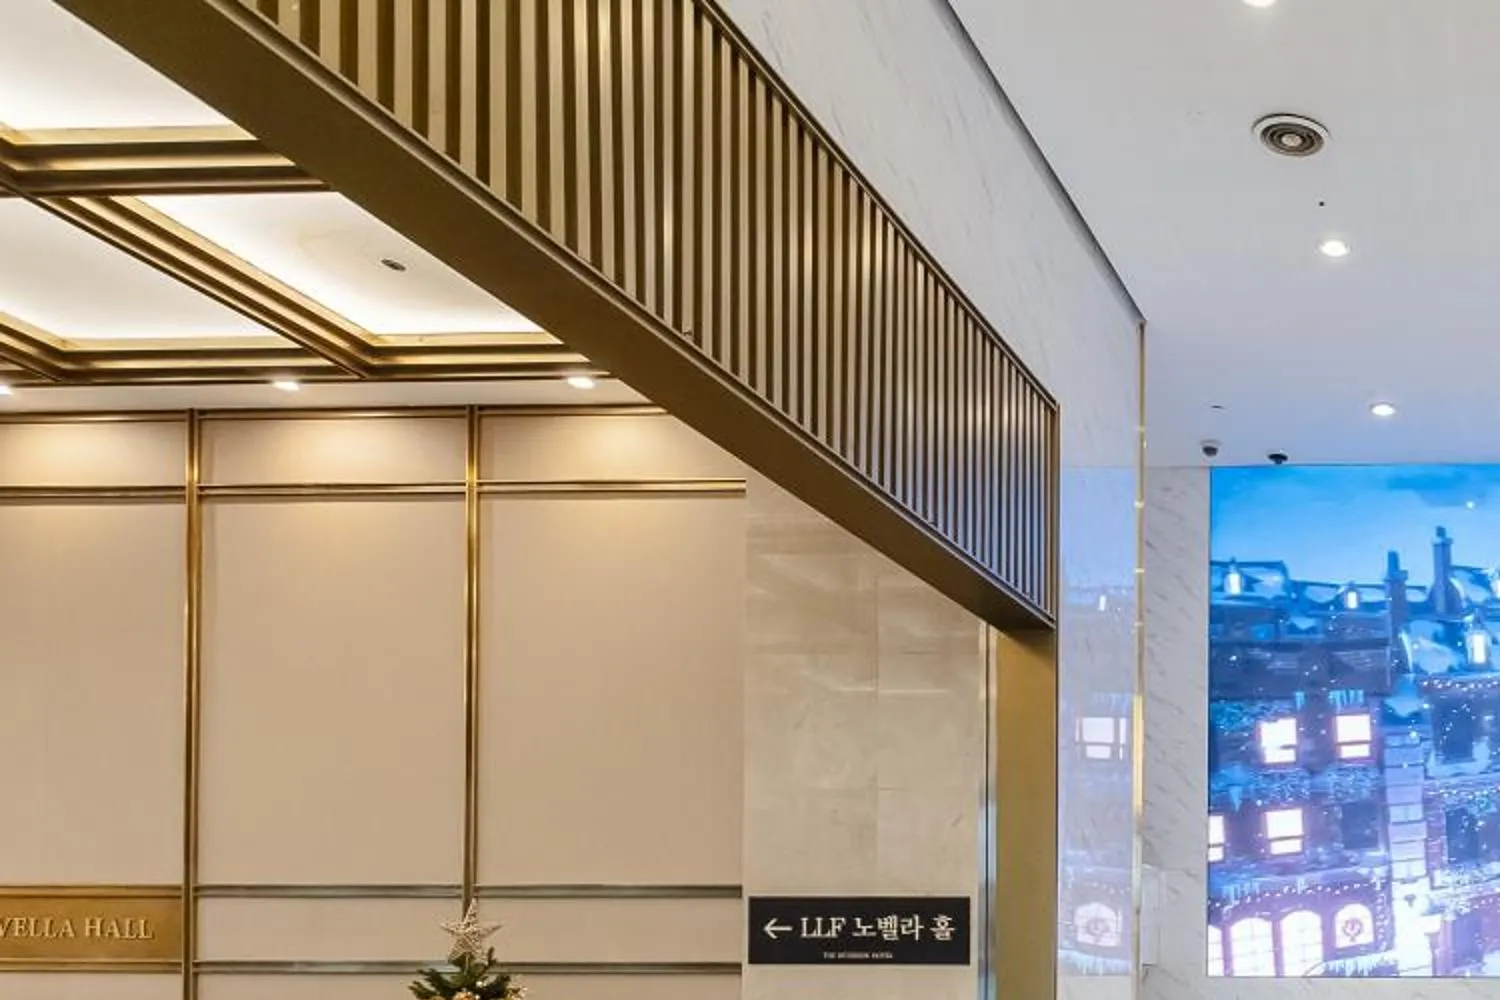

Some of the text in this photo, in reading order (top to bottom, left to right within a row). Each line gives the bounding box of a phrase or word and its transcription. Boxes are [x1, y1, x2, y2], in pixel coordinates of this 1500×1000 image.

[85, 917, 154, 940] HALL
[800, 914, 955, 941] LLF 노벨라 홀
